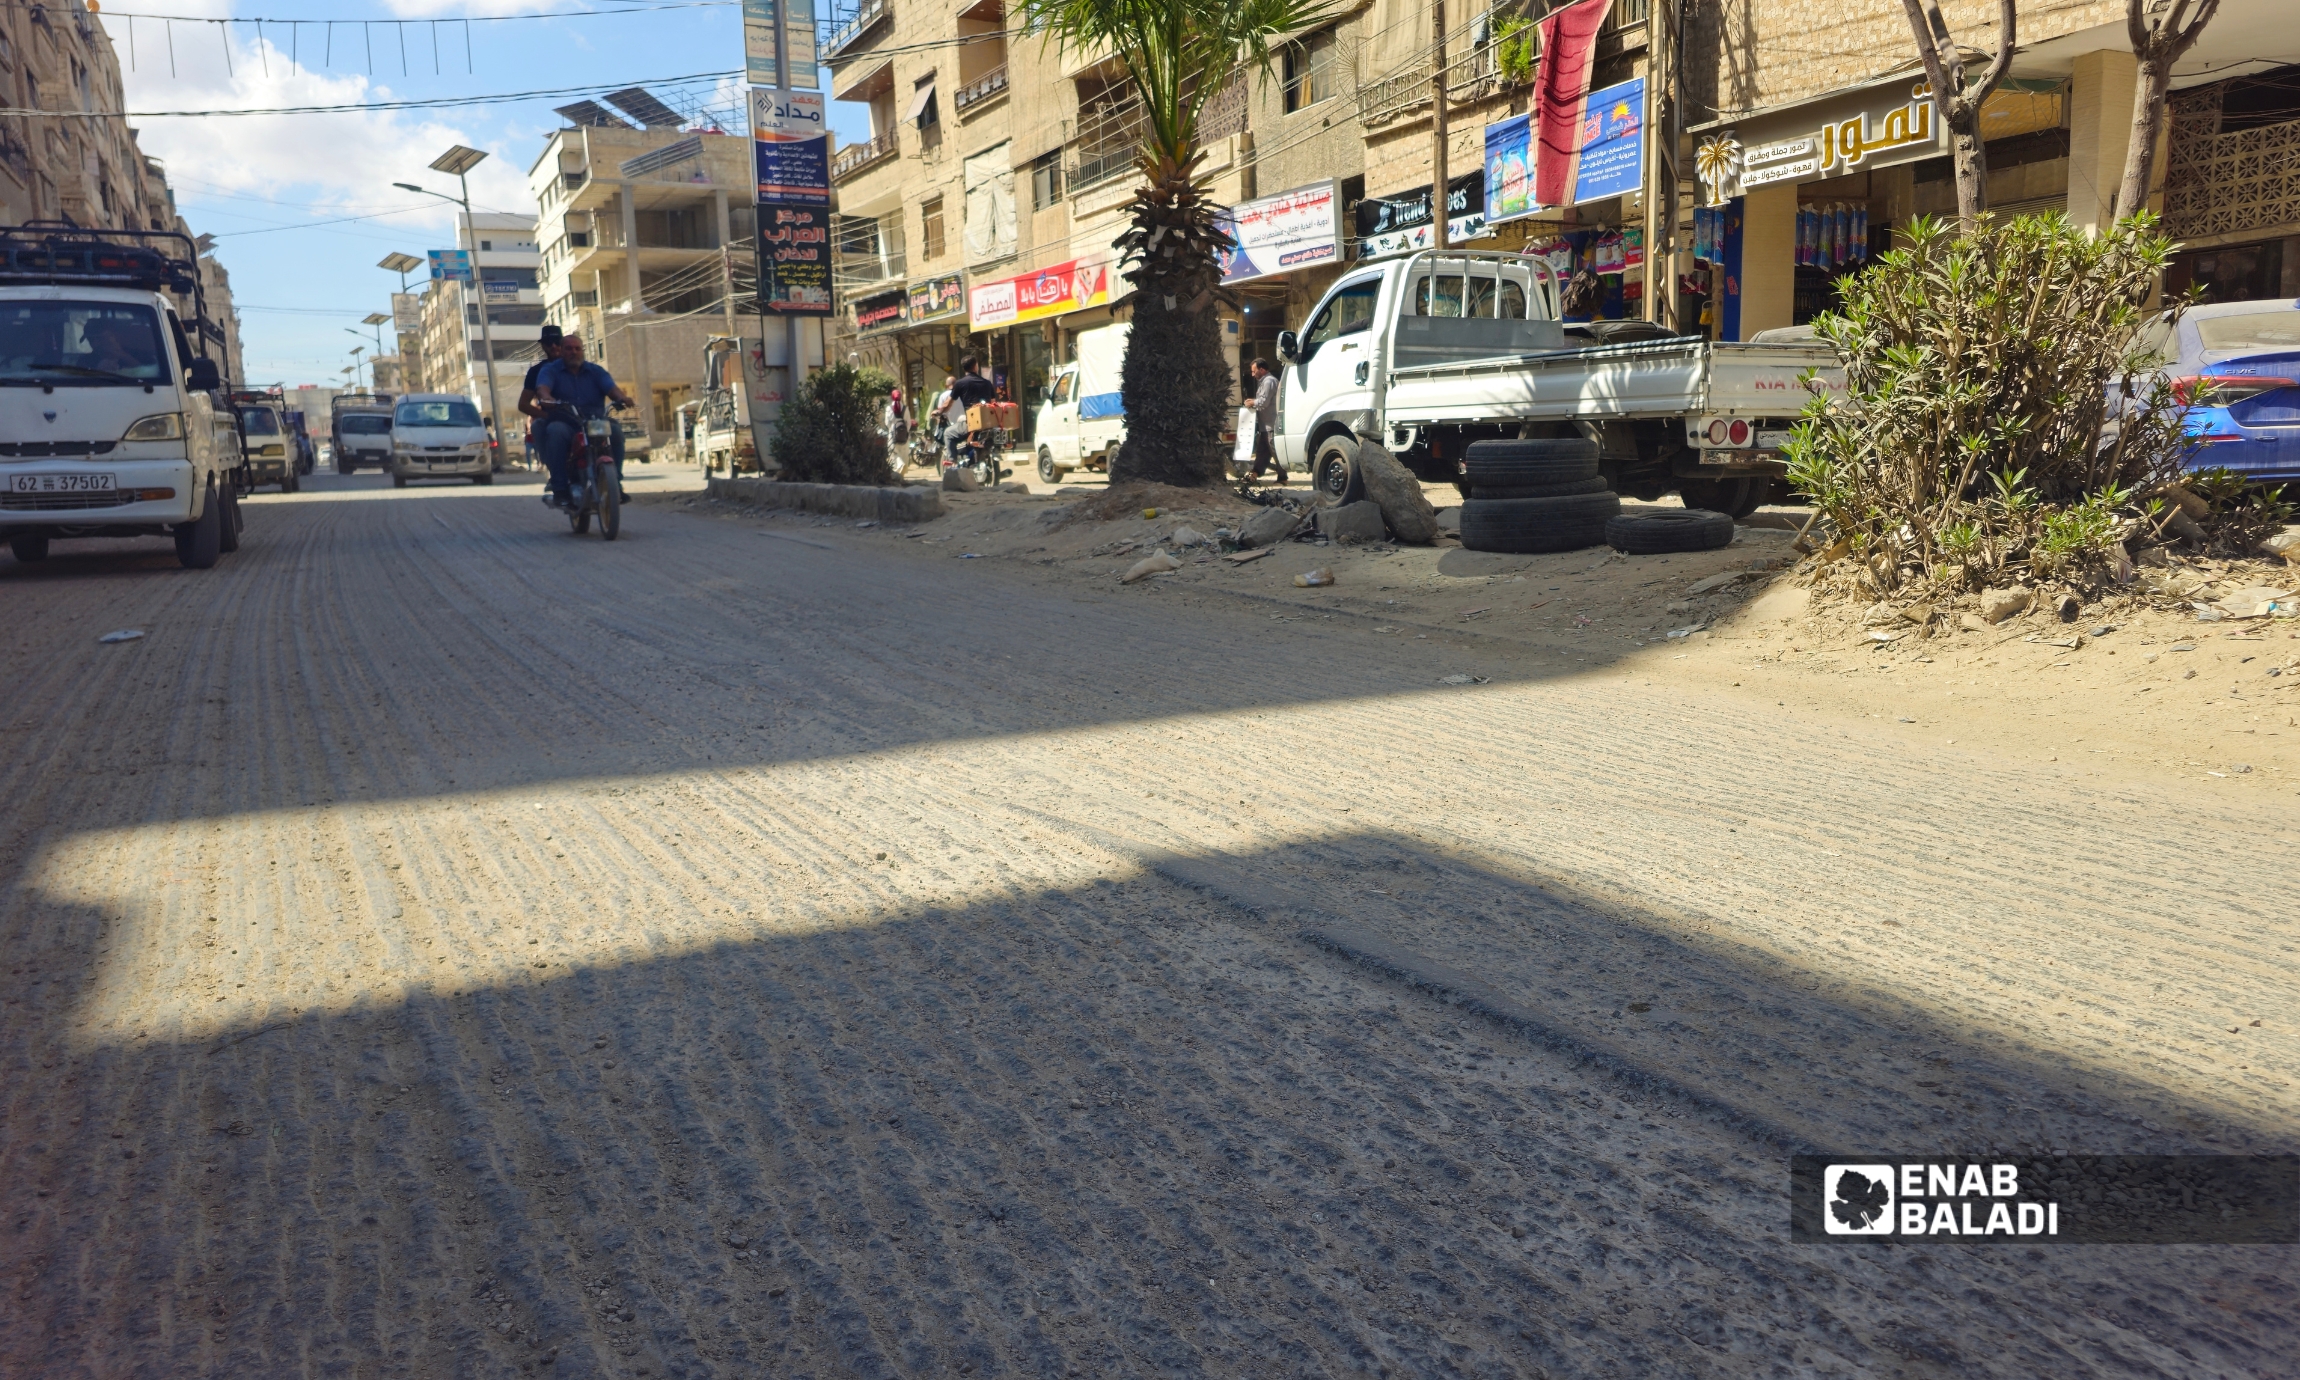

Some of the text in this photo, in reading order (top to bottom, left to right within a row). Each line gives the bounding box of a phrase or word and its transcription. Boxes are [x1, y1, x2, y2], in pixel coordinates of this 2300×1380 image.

[1820, 81, 1939, 172] تمور
[1748, 142, 1806, 163] تمور جملة ومفرق
[1761, 166, 1788, 180] شوكولا
[1793, 162, 1812, 173] قهوة
[1743, 174, 1758, 184] ملبن
[1429, 188, 1467, 217] Soes
[775, 209, 813, 226] مركز
[1755, 375, 1786, 390] KIA
[18, 476, 37, 491] 62
[60, 475, 110, 490] 37502
